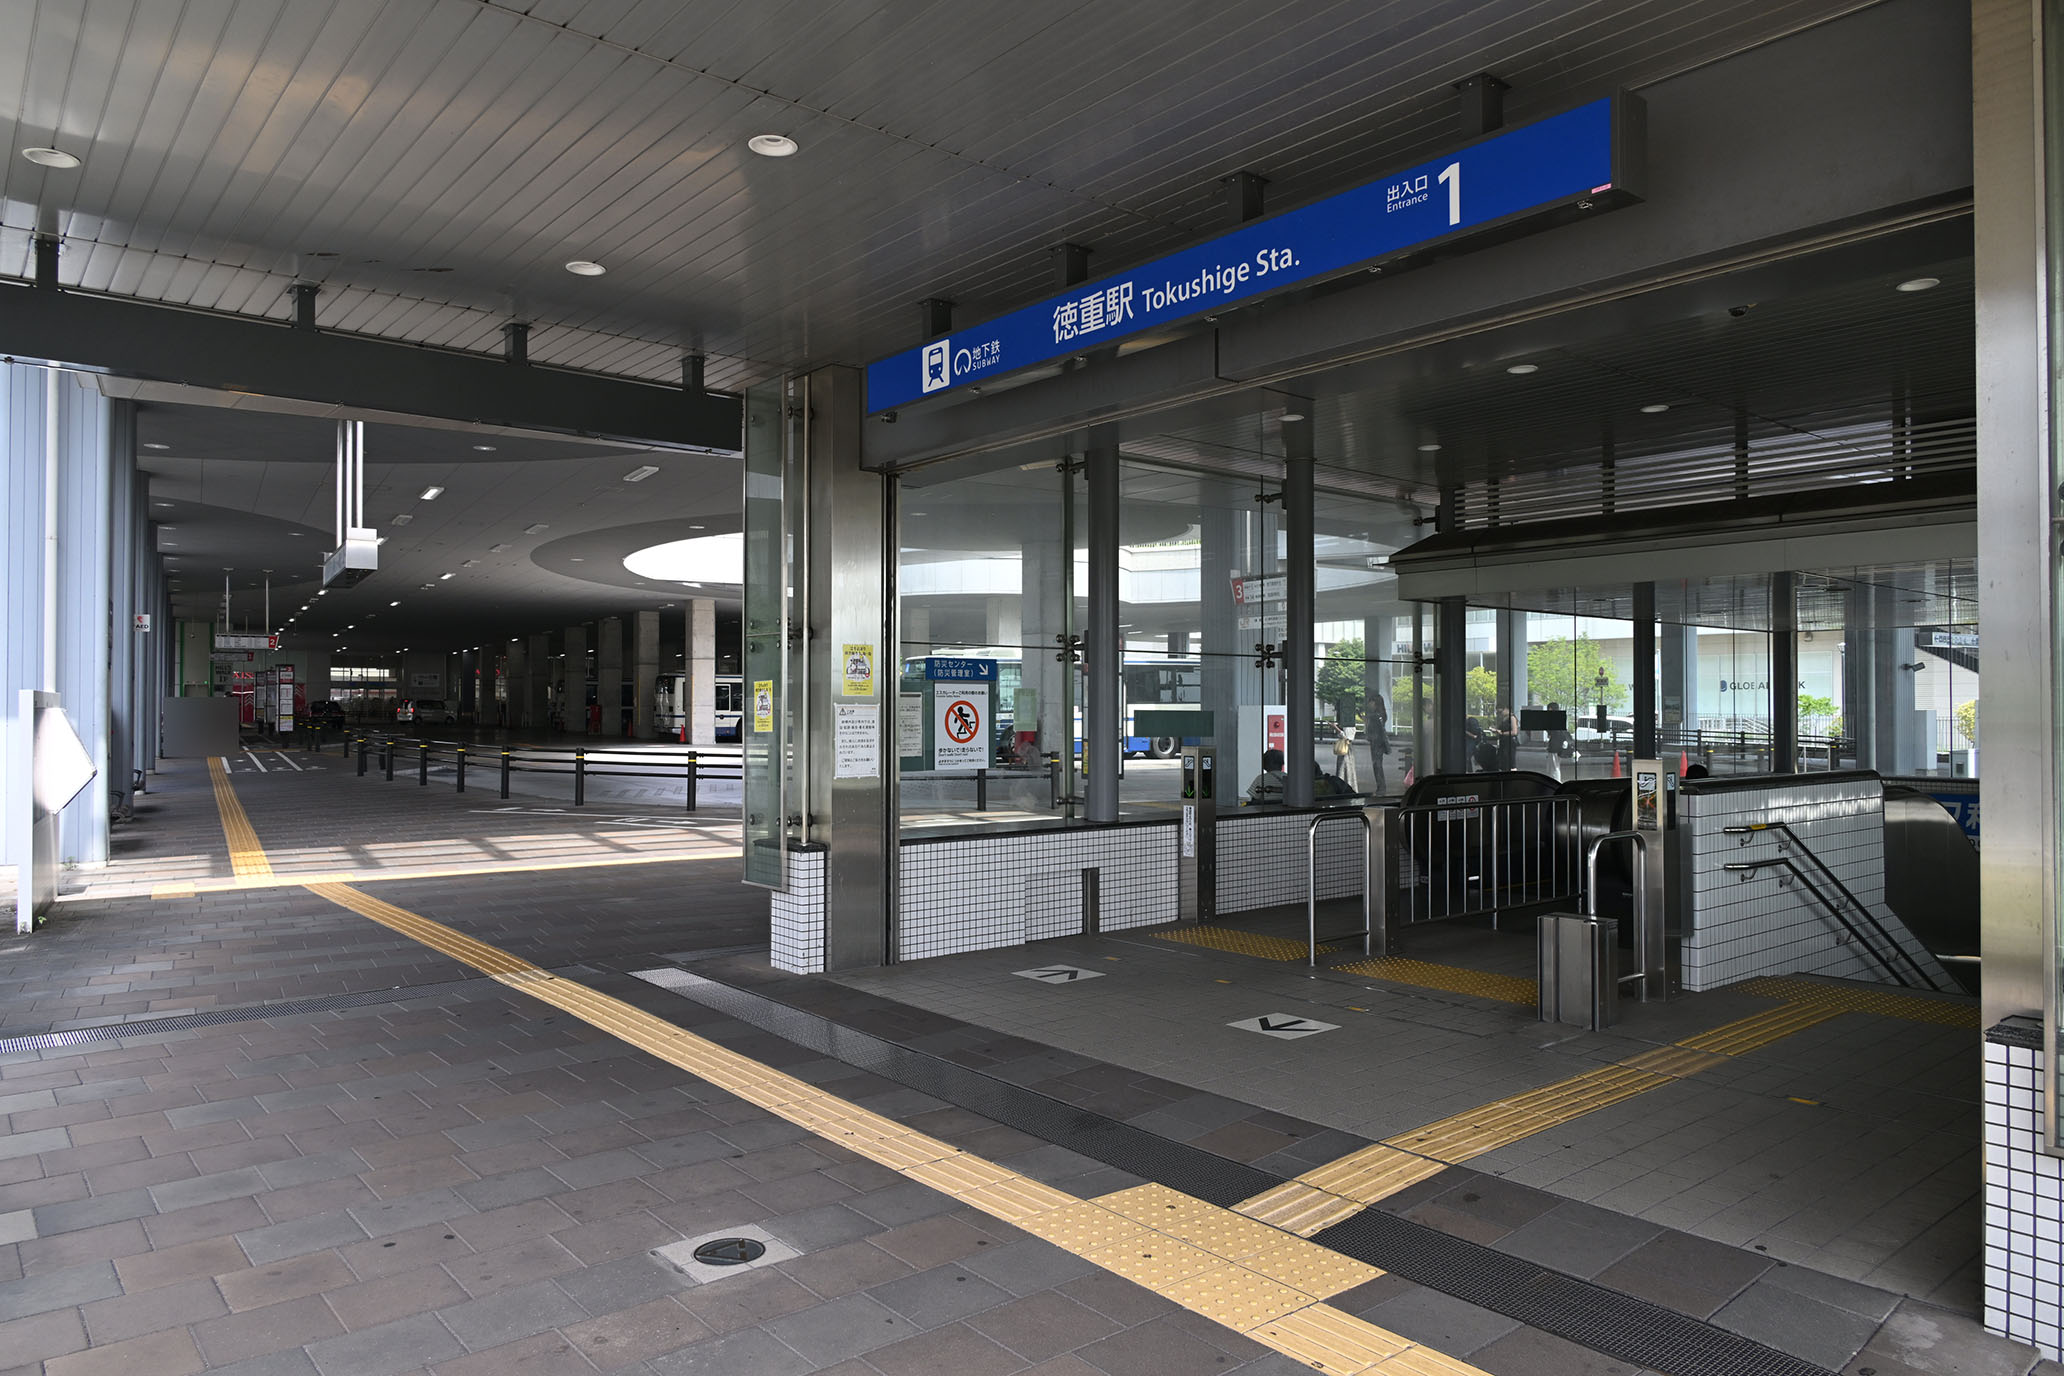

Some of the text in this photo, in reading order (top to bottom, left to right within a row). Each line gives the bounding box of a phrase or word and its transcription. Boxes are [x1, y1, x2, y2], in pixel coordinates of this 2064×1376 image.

[1386, 174, 1429, 203] 出入口
[1437, 161, 1461, 226] 1
[1386, 192, 1429, 213] Entrance
[1141, 248, 1301, 313] Tokushige Sta.
[1052, 281, 1135, 344] 徳重駅
[972, 341, 1001, 361] 地下鉄
[972, 353, 1001, 372] SUBWAY
[1235, 585, 1243, 599] 3
[270, 638, 276, 646] 2
[934, 660, 973, 668] 防災センター
